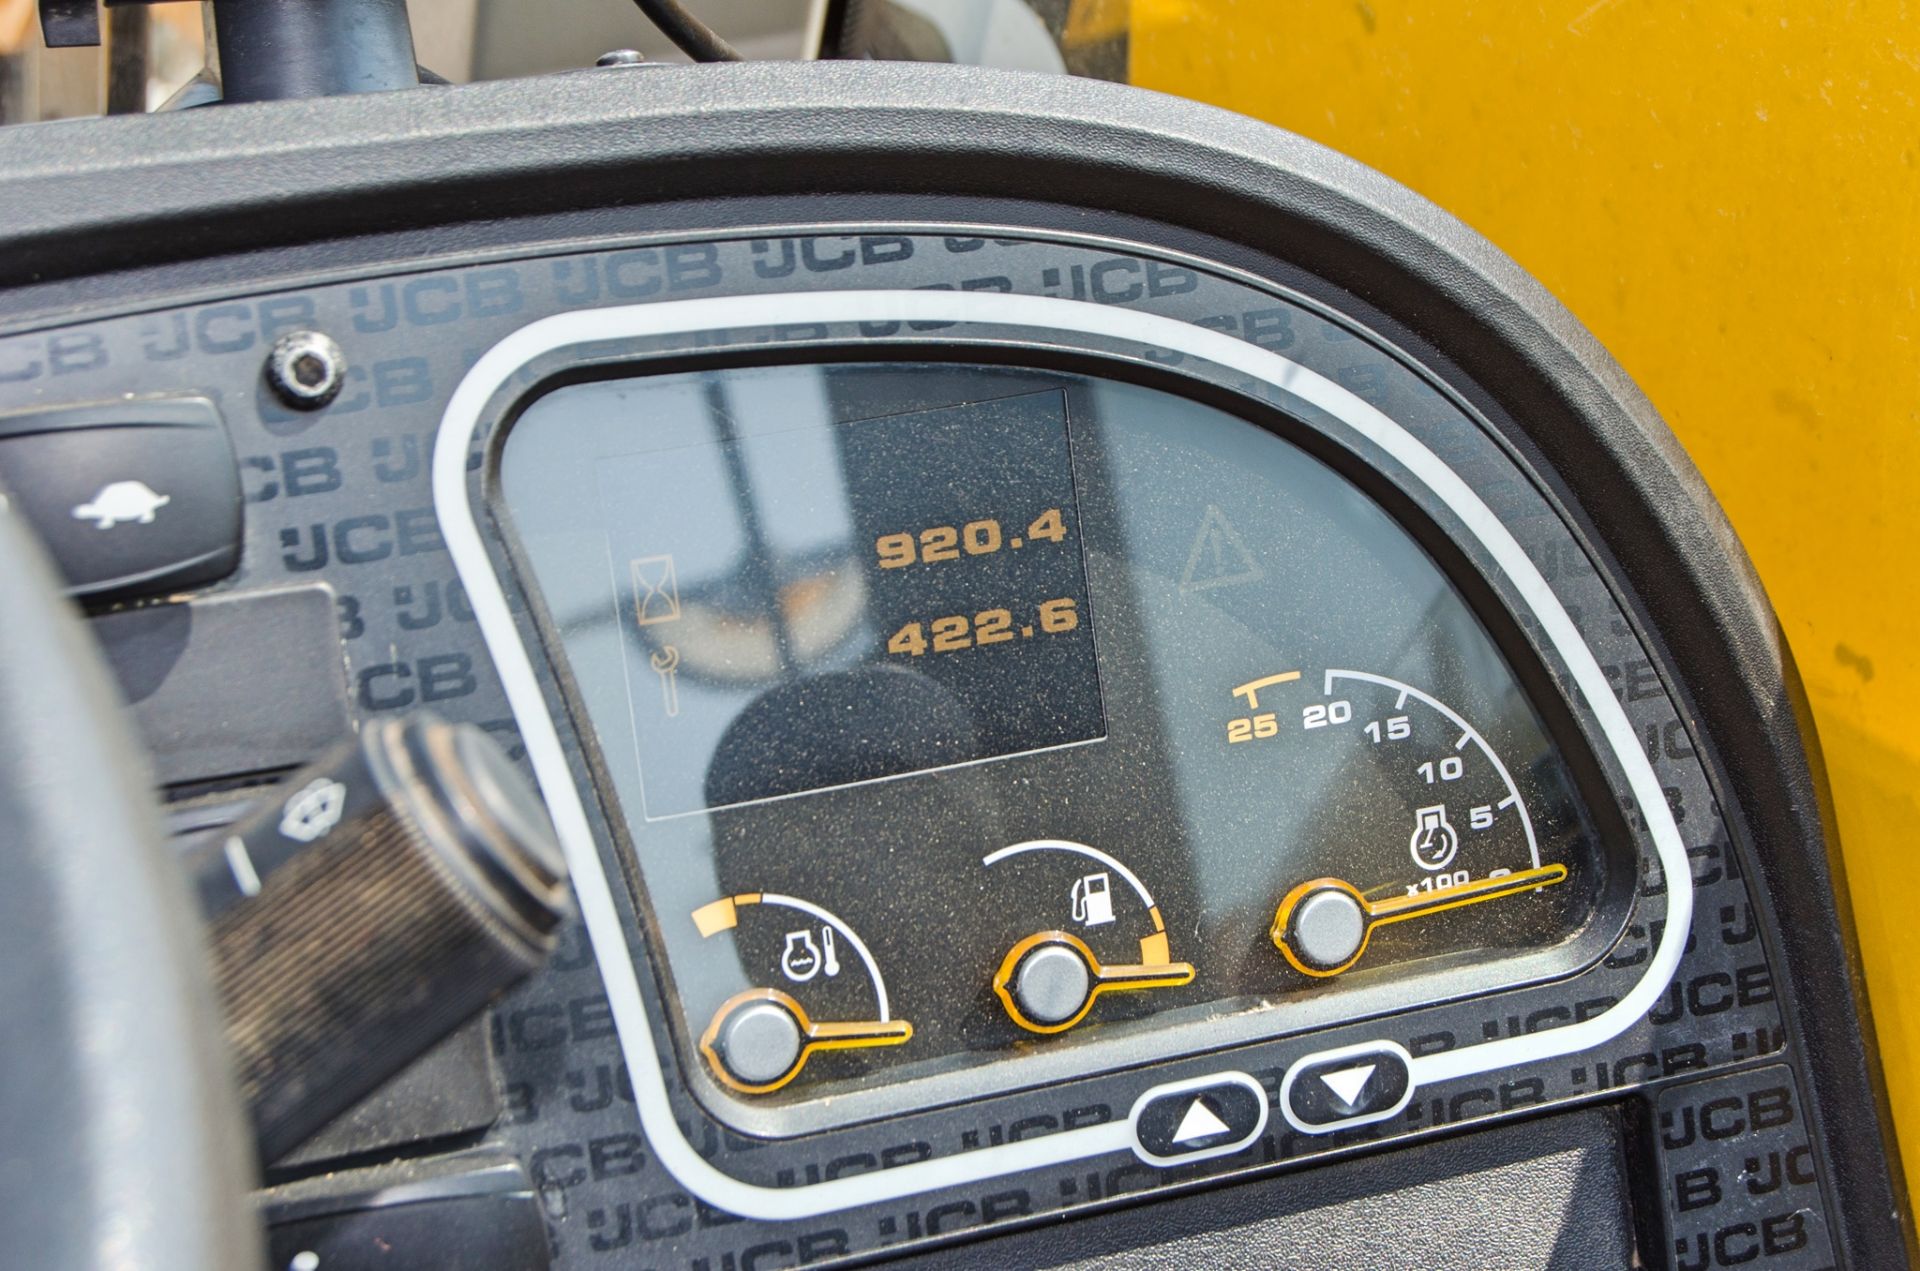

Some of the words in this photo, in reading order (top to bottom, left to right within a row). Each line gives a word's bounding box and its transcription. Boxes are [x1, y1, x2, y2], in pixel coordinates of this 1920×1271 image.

[350, 268, 524, 333] JCB
[876, 508, 1067, 569] 920.4
[888, 597, 1078, 656] 422.6
[1227, 713, 1278, 744] 25
[1303, 701, 1351, 729] 20
[1364, 716, 1411, 743] 15
[1417, 757, 1463, 784] 10
[1470, 806, 1494, 830] 5
[1662, 1086, 1794, 1151] JCB
[1675, 1211, 1808, 1271] JCB
